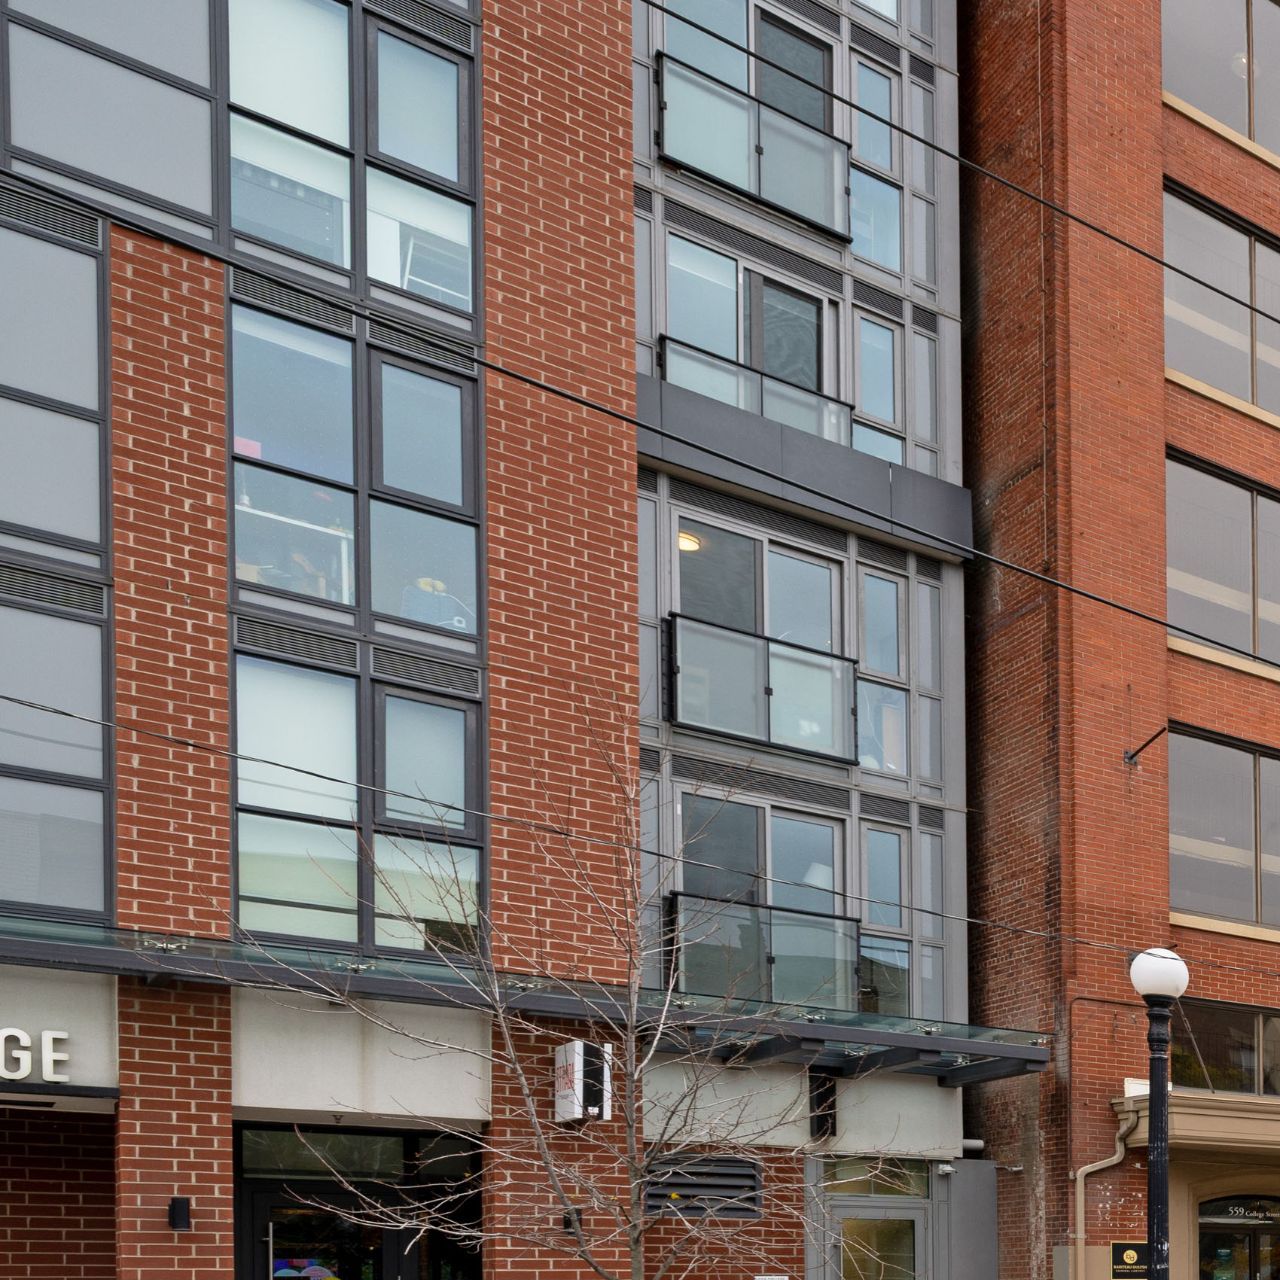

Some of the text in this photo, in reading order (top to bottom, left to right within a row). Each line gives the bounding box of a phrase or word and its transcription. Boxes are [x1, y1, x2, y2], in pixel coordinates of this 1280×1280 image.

[0, 1028, 70, 1082] GE
[1228, 1206, 1245, 1216] 559
[1245, 1210, 1265, 1218] College
